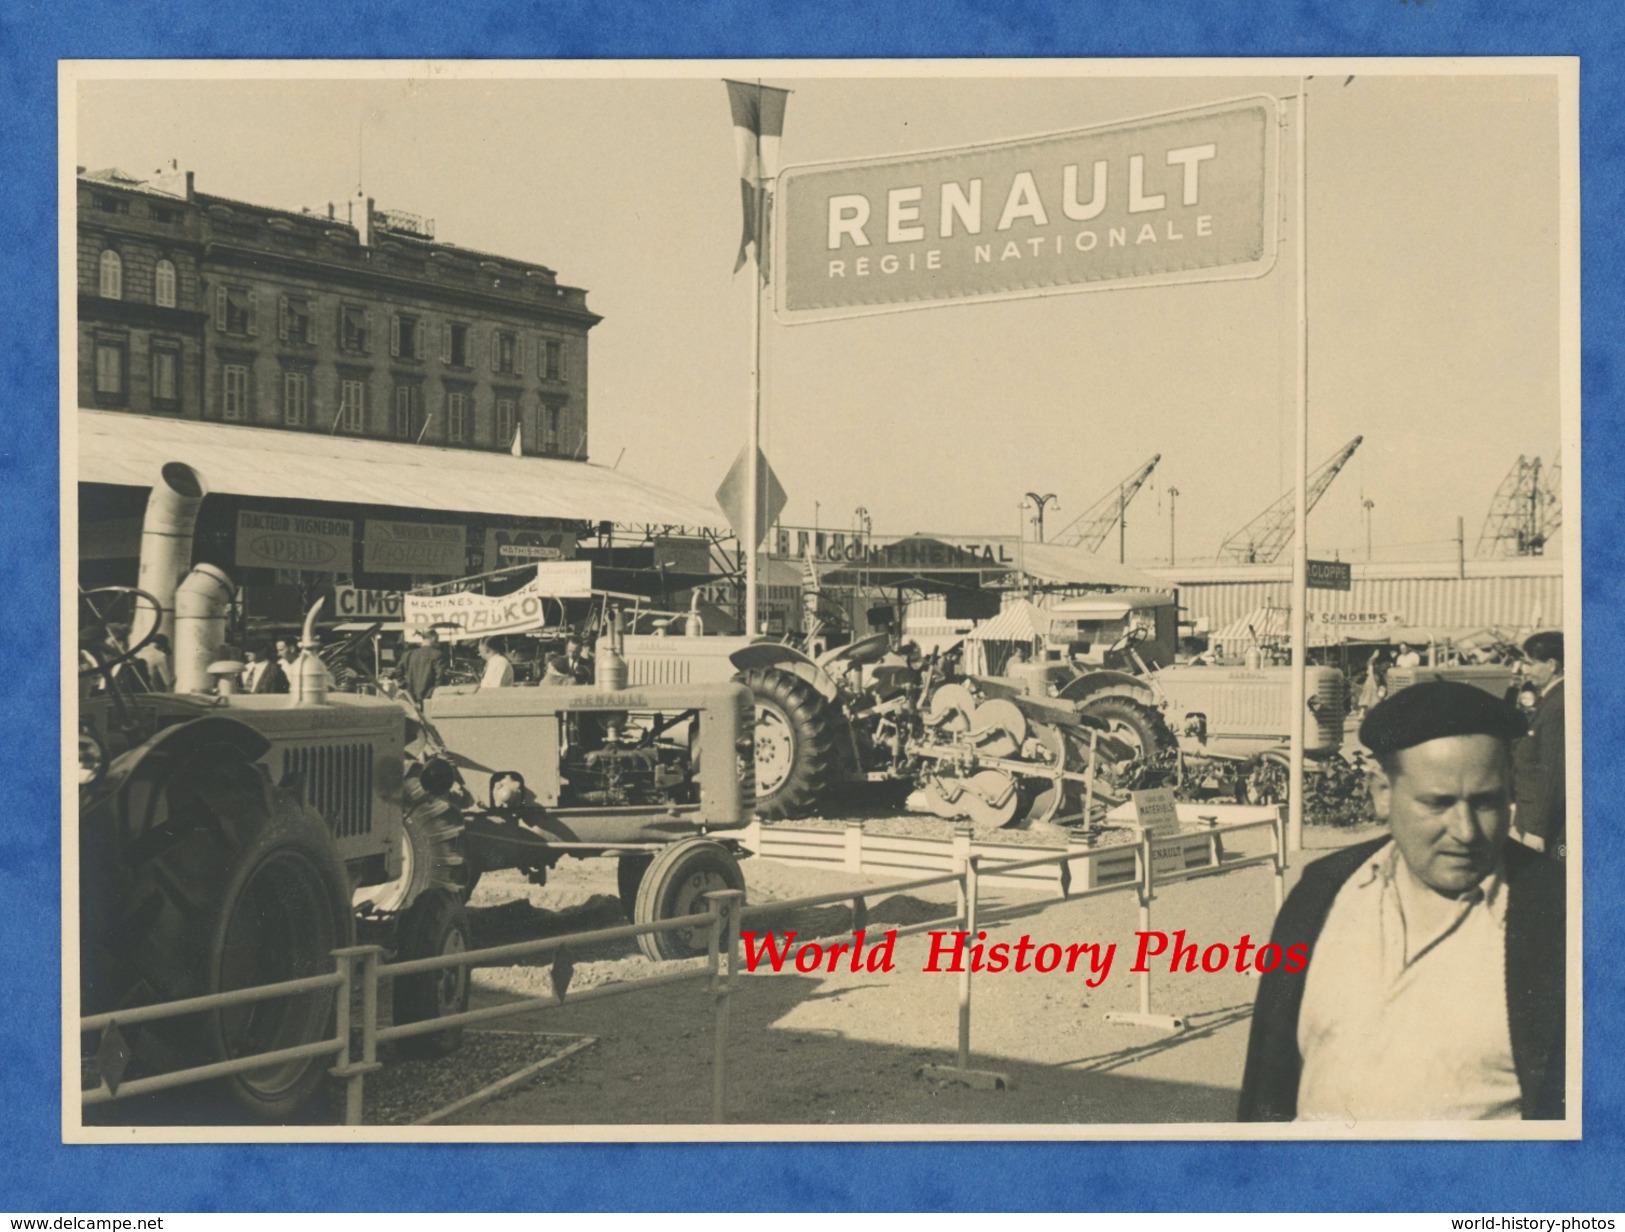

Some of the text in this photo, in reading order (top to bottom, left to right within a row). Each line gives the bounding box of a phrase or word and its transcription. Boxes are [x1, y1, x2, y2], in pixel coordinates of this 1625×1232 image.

[827, 143, 1217, 250] RENAULT
[974, 215, 1214, 264] NATIONALE
[240, 513, 350, 537] TRACTEUR VIGNERON
[827, 545, 1014, 564] CONTINENTAL
[411, 597, 473, 609] MACHINES
[1321, 612, 1388, 624] SANDERS
[573, 693, 647, 707] RENAULT
[1152, 847, 1181, 860] ENAULT
